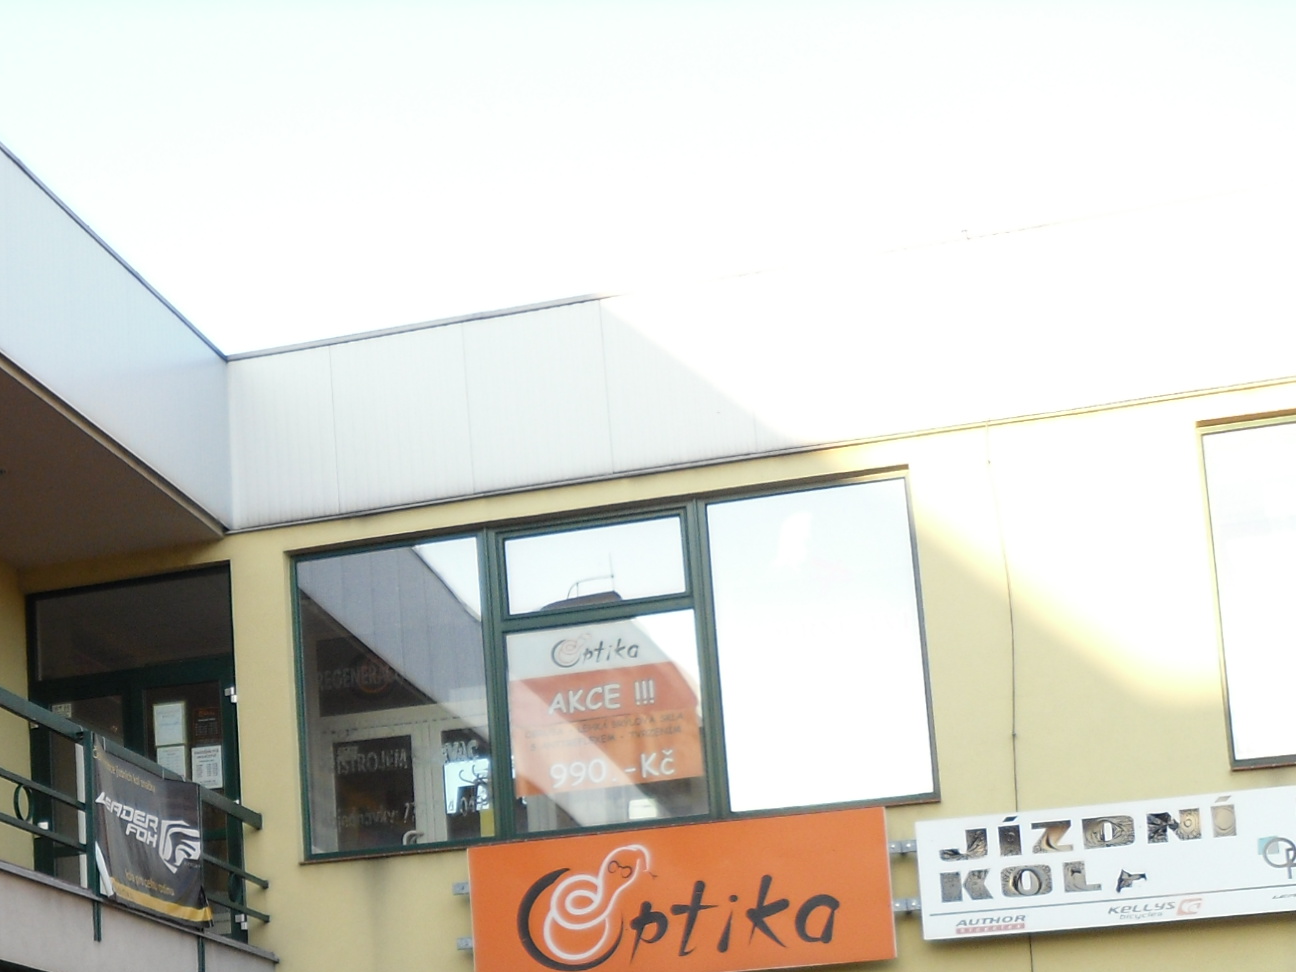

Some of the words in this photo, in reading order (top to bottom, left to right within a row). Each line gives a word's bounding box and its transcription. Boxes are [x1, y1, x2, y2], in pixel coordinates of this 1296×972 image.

[548, 683, 622, 715] AKCE
[95, 791, 160, 833] LEADER
[939, 795, 1238, 863] JÍZDNÍ
[517, 844, 842, 972] Optika
[955, 914, 1026, 927] AUTHOR
